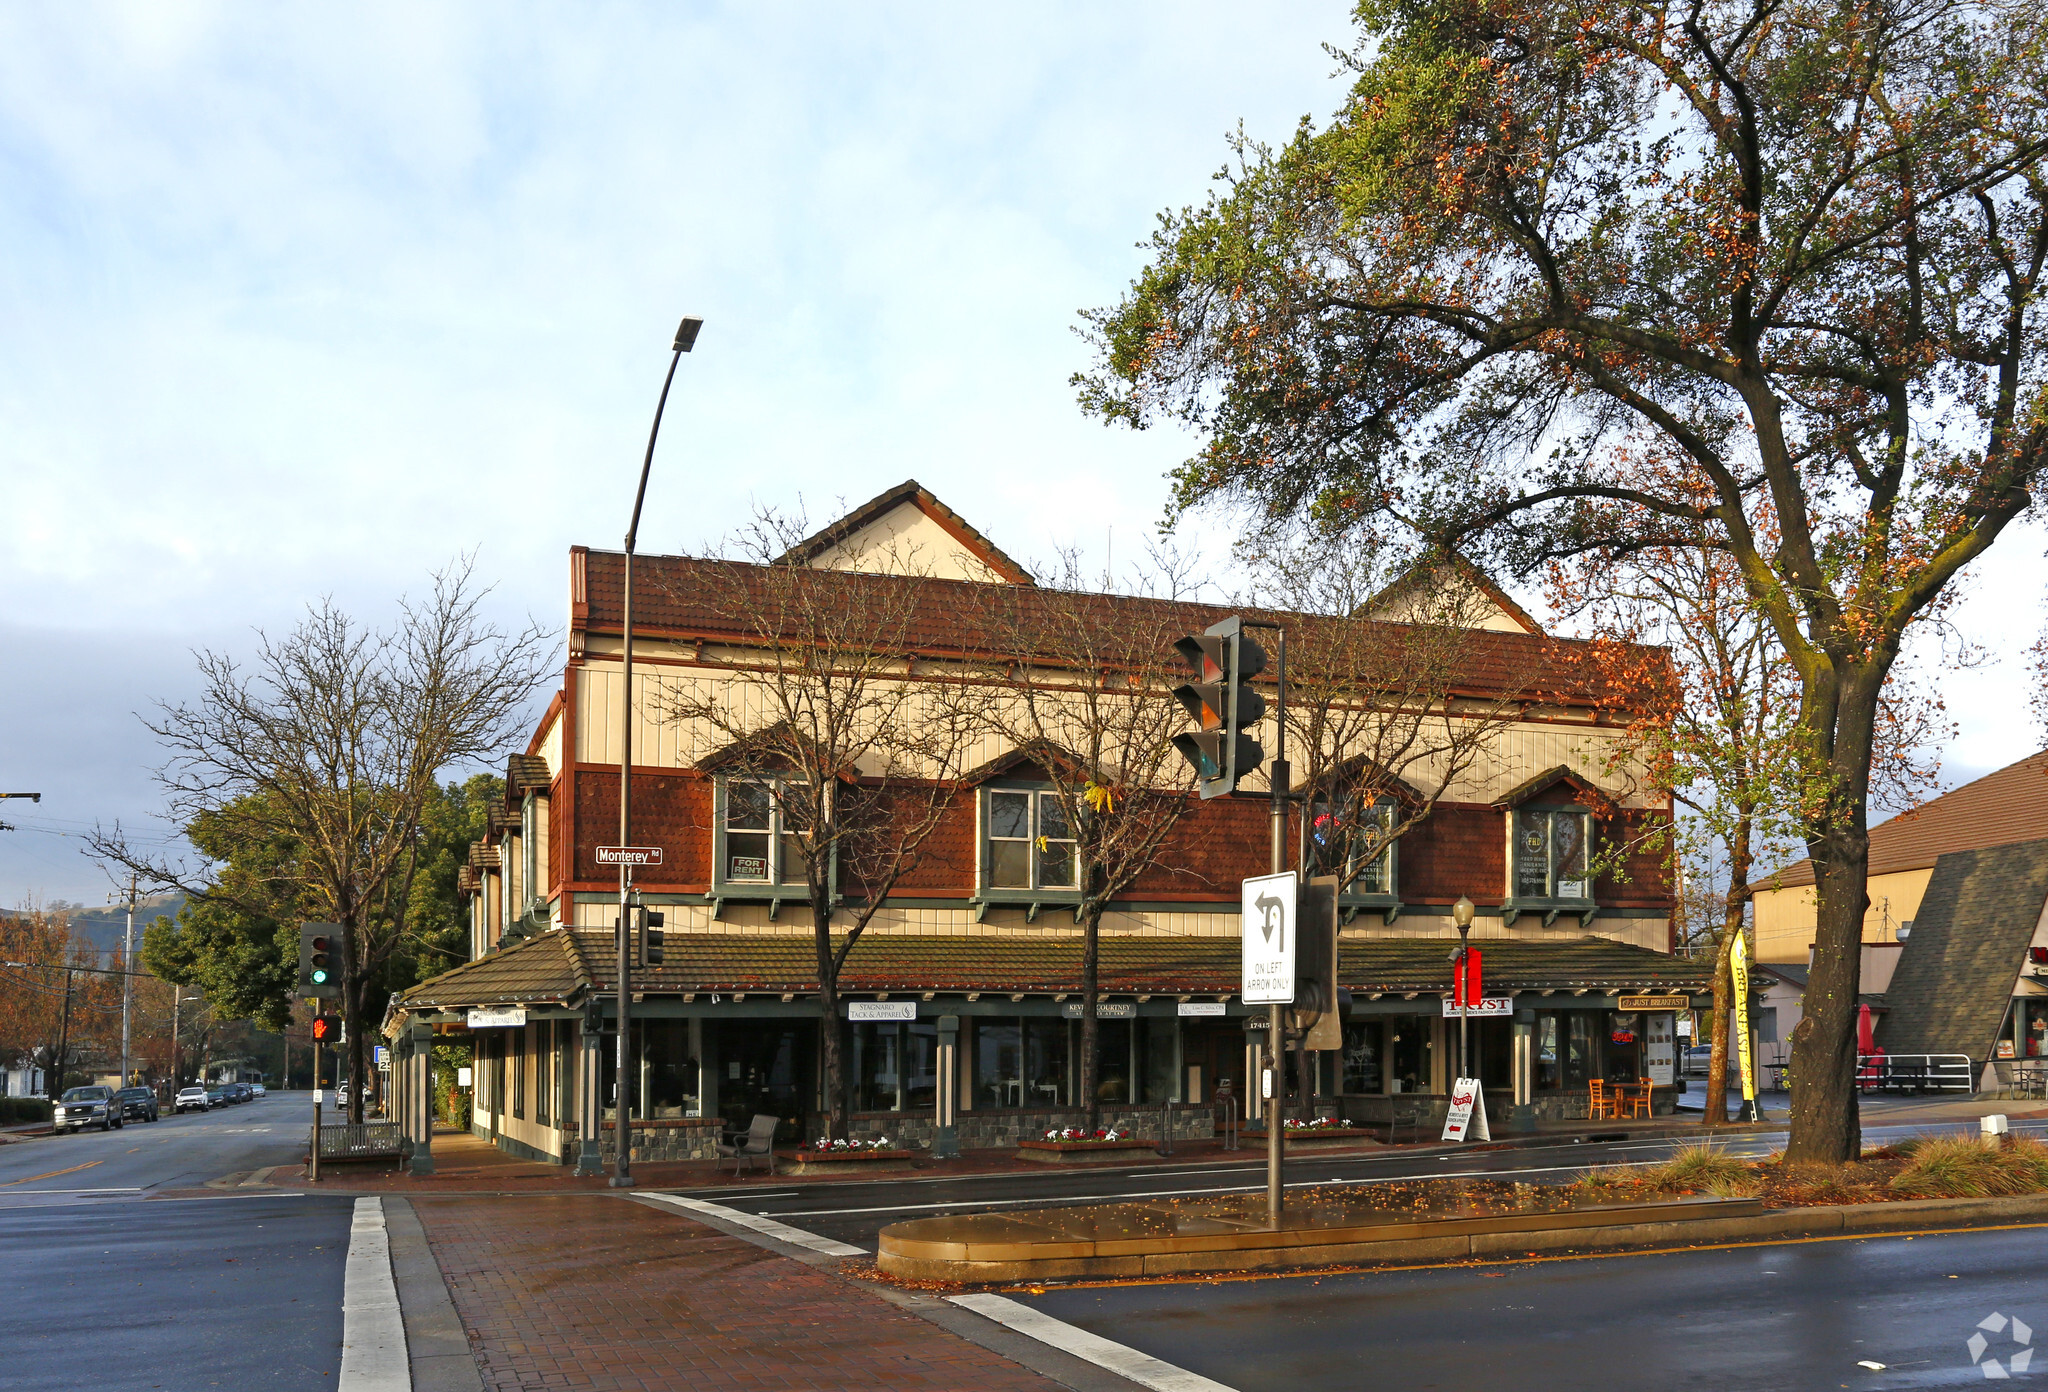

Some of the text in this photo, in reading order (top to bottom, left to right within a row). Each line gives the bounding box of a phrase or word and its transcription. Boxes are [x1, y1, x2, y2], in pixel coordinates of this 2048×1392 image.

[599, 848, 649, 864] Monterey
[738, 859, 760, 867] FOR
[734, 865, 763, 874] RENT
[1255, 961, 1282, 974] ON LEFT
[1247, 977, 1290, 991] ARROW ONLY
[1633, 998, 1685, 1006] JUST BREAKFAST
[859, 1003, 895, 1011] STAGNARO
[1069, 1003, 1131, 1011] KEVI COURTNEY
[850, 1010, 903, 1019] TACK & APPAREL
